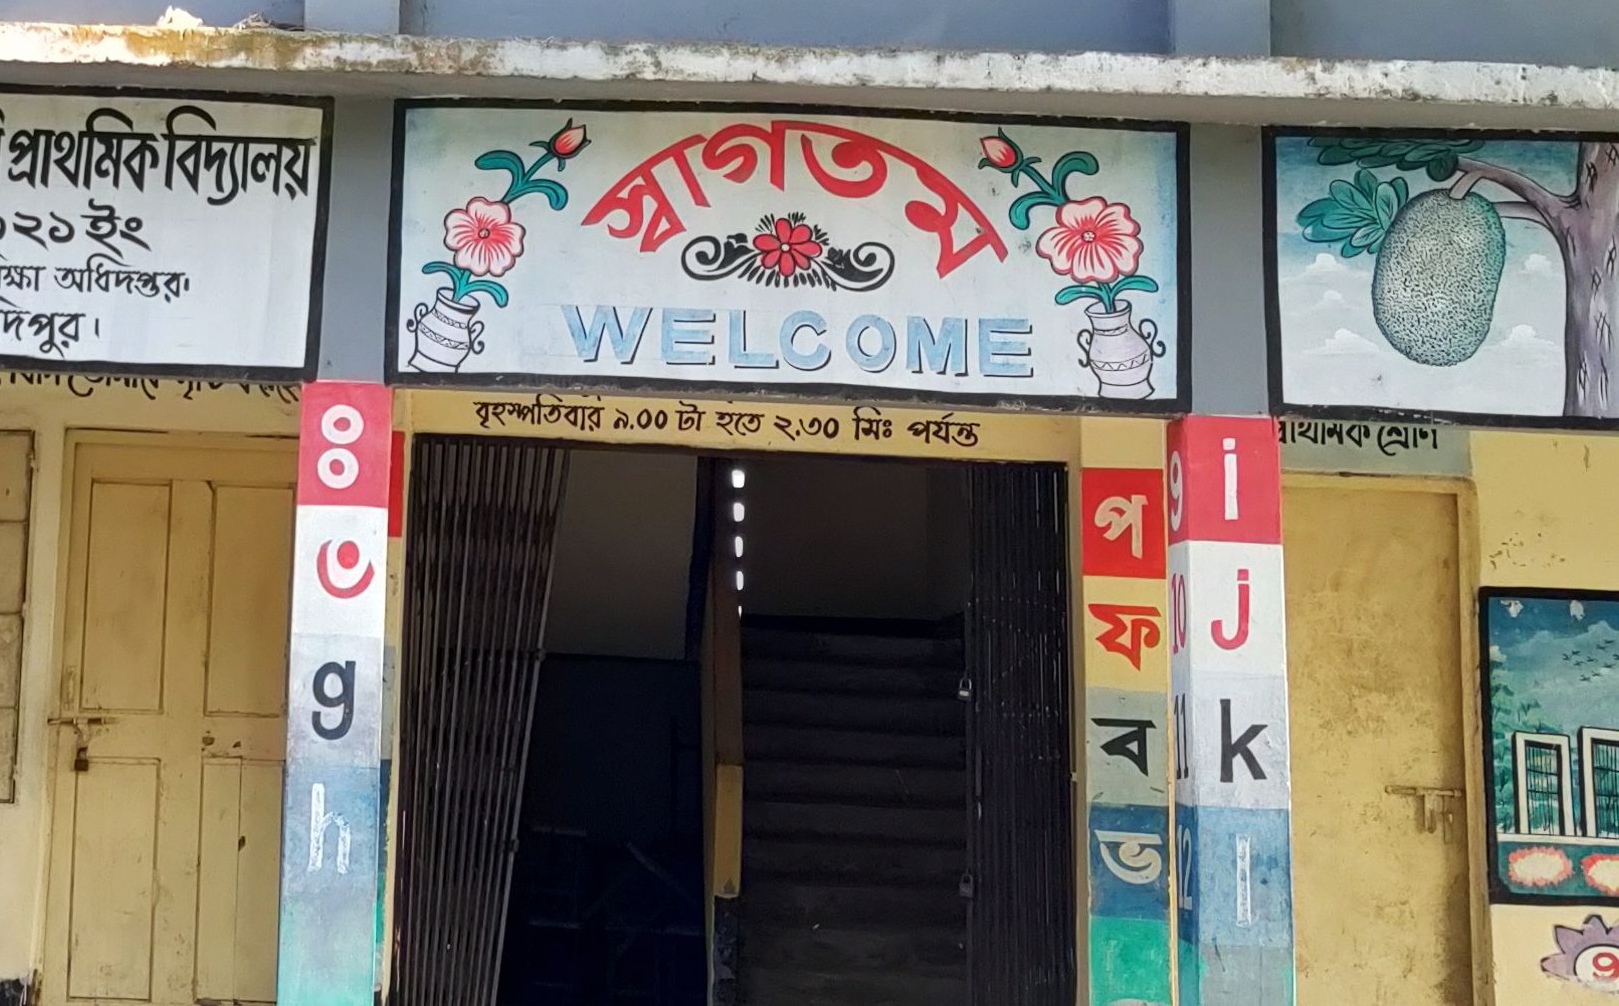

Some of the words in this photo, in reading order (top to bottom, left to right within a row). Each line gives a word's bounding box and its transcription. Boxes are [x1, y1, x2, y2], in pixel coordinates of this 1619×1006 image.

[9, 108, 159, 192] প্রাথমিক
[162, 105, 316, 206] বিদ্যালয়
[81, 198, 151, 258] ইং
[581, 120, 1009, 280] স্বাগতম
[561, 303, 1035, 378] WELCOME
[675, 400, 706, 432] টা
[716, 410, 764, 437] হতে
[908, 412, 986, 447] পর্যন্ত
[1170, 450, 1183, 531] 9
[1222, 437, 1239, 521] i
[1094, 493, 1148, 558] প
[1088, 604, 1162, 670] ফ
[1171, 573, 1186, 654] 10
[1210, 568, 1250, 650] j
[312, 660, 356, 740] g
[1174, 693, 1189, 779] 11
[1091, 718, 1157, 777] ব
[1219, 699, 1269, 784] k
[308, 782, 350, 874] h
[1094, 829, 1163, 884] ভ
